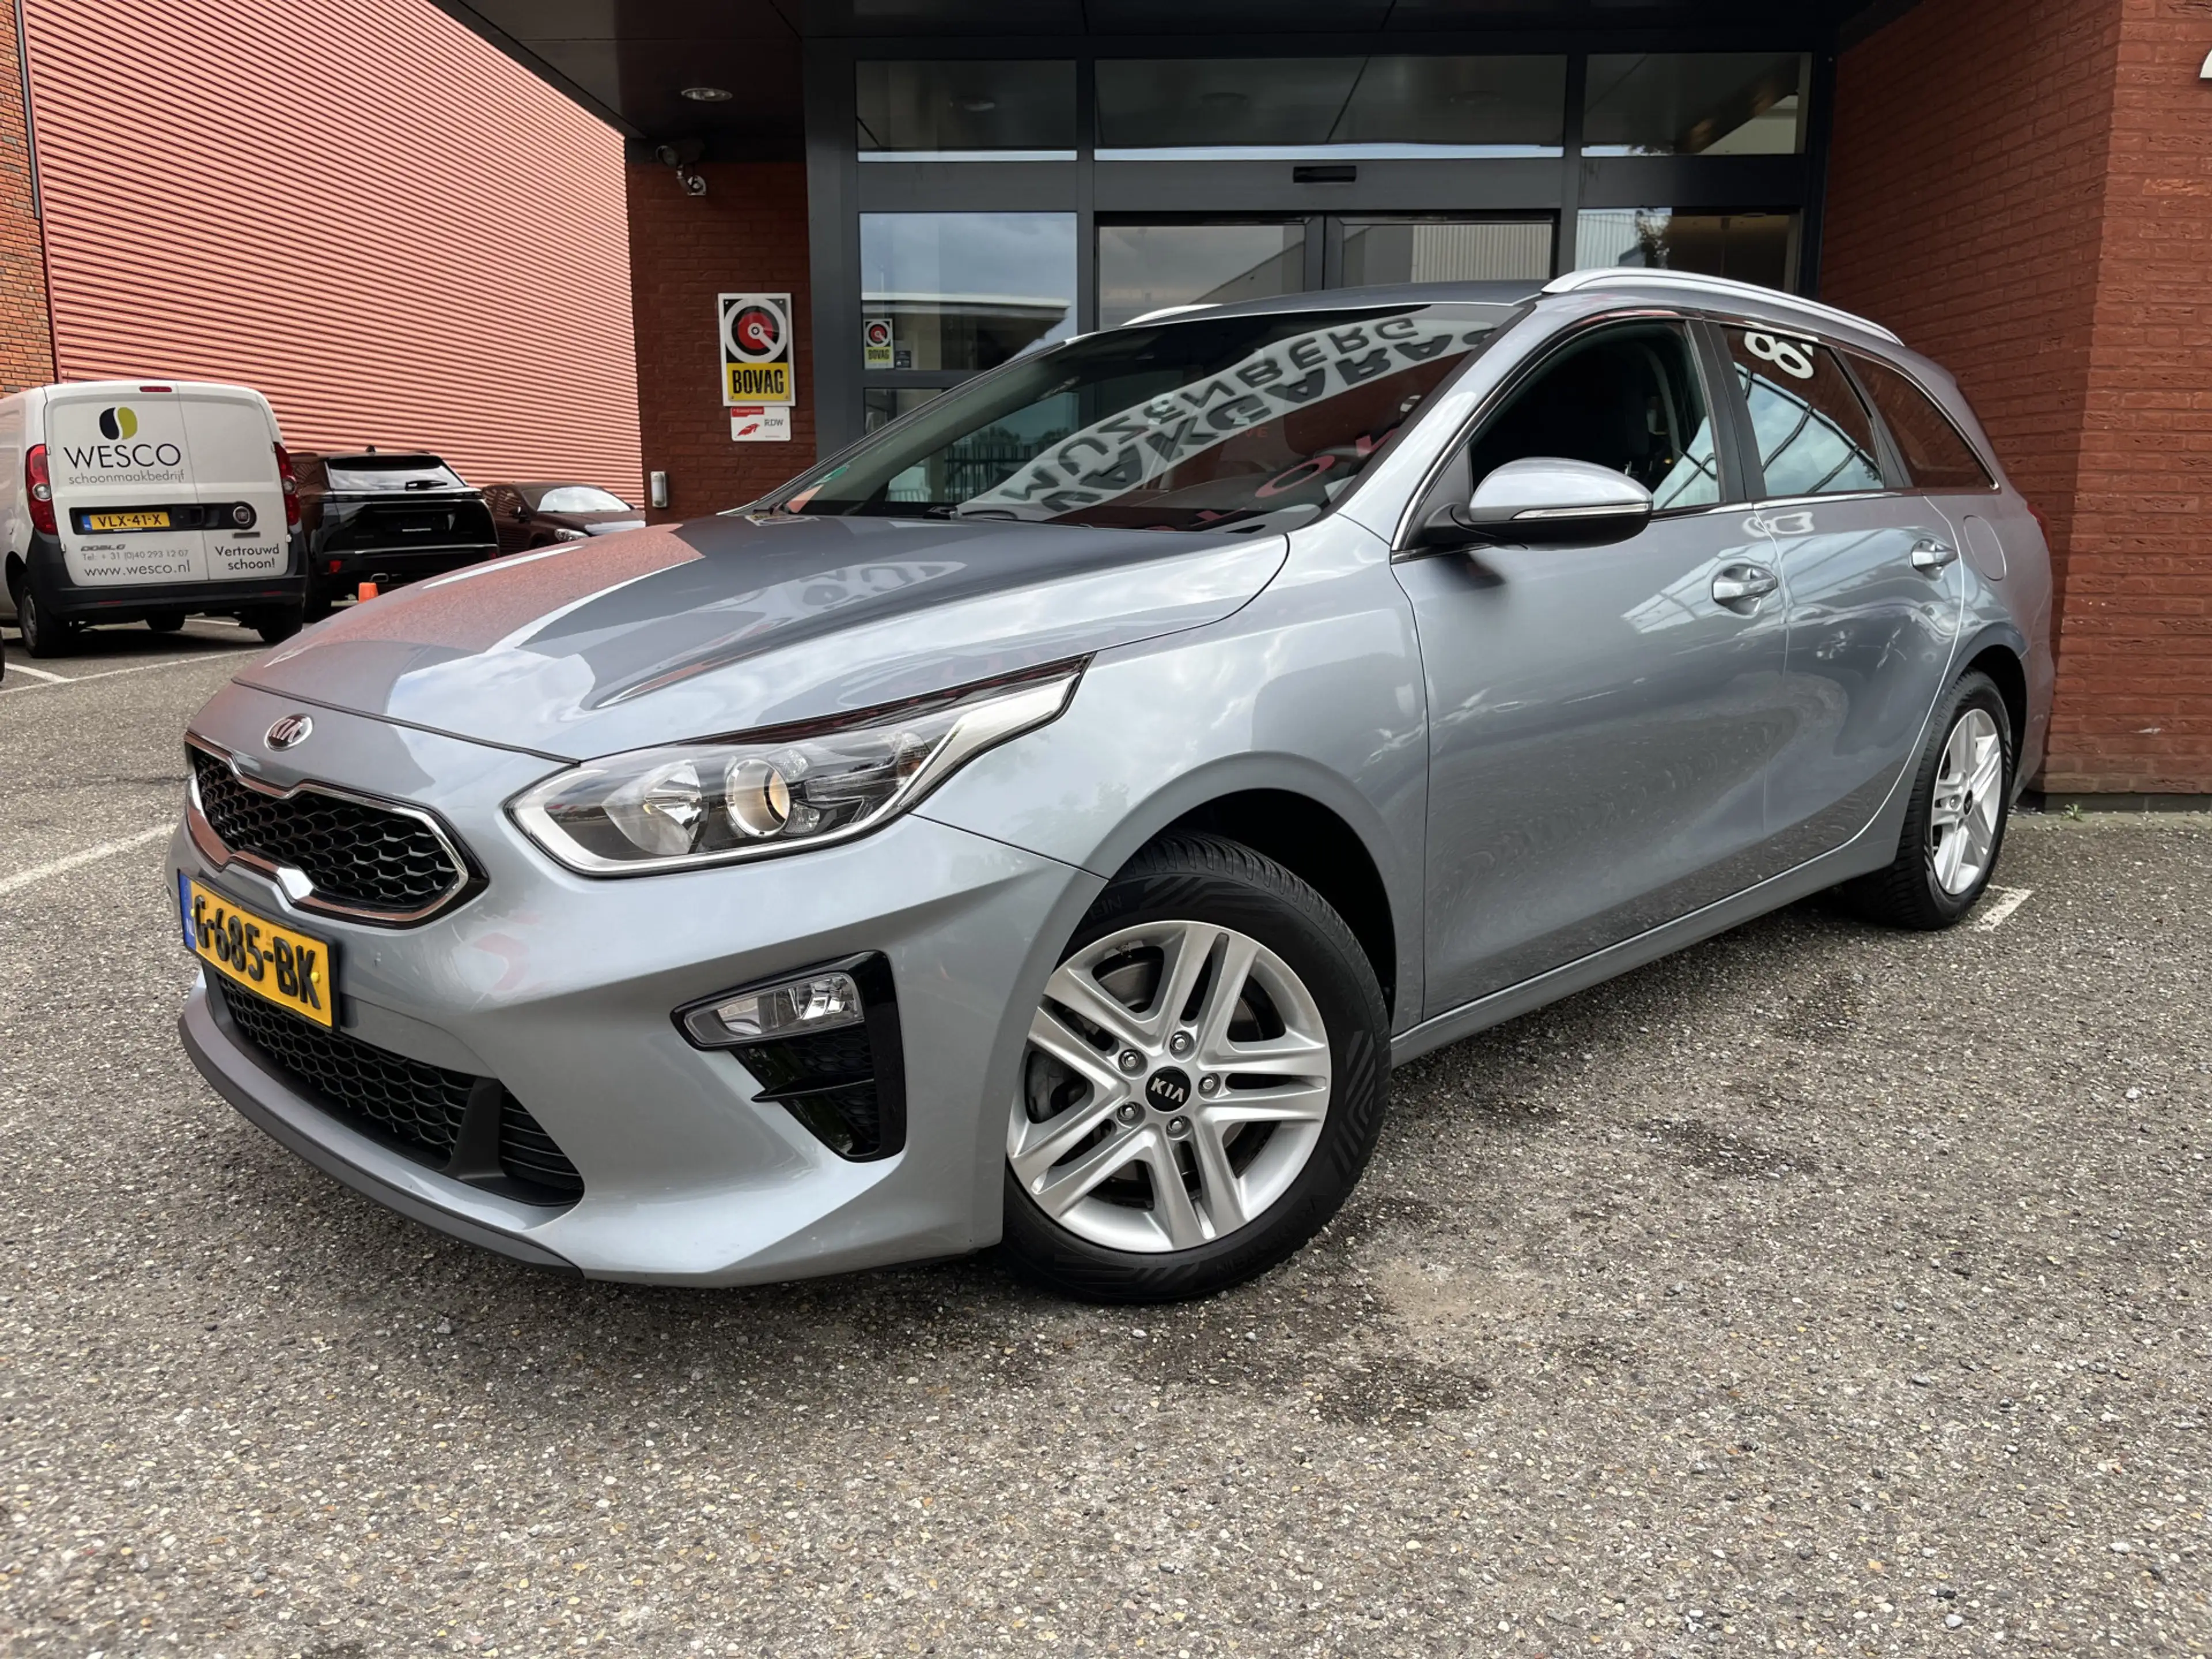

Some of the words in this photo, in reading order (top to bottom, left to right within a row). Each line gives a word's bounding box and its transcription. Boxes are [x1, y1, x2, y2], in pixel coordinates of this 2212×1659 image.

[732, 369, 784, 395] BOVAG
[764, 419, 783, 427] RDW
[63, 443, 181, 469] WESCO
[69, 469, 185, 485] schoonmaakbedrijf
[97, 513, 162, 528] VLX-41-X
[214, 544, 280, 557] Vertrouwd
[84, 559, 191, 577] www.wesco.nl
[228, 558, 275, 570] schoon!
[194, 895, 321, 1010] G-685-BK
[1151, 1077, 1184, 1103] KIA
